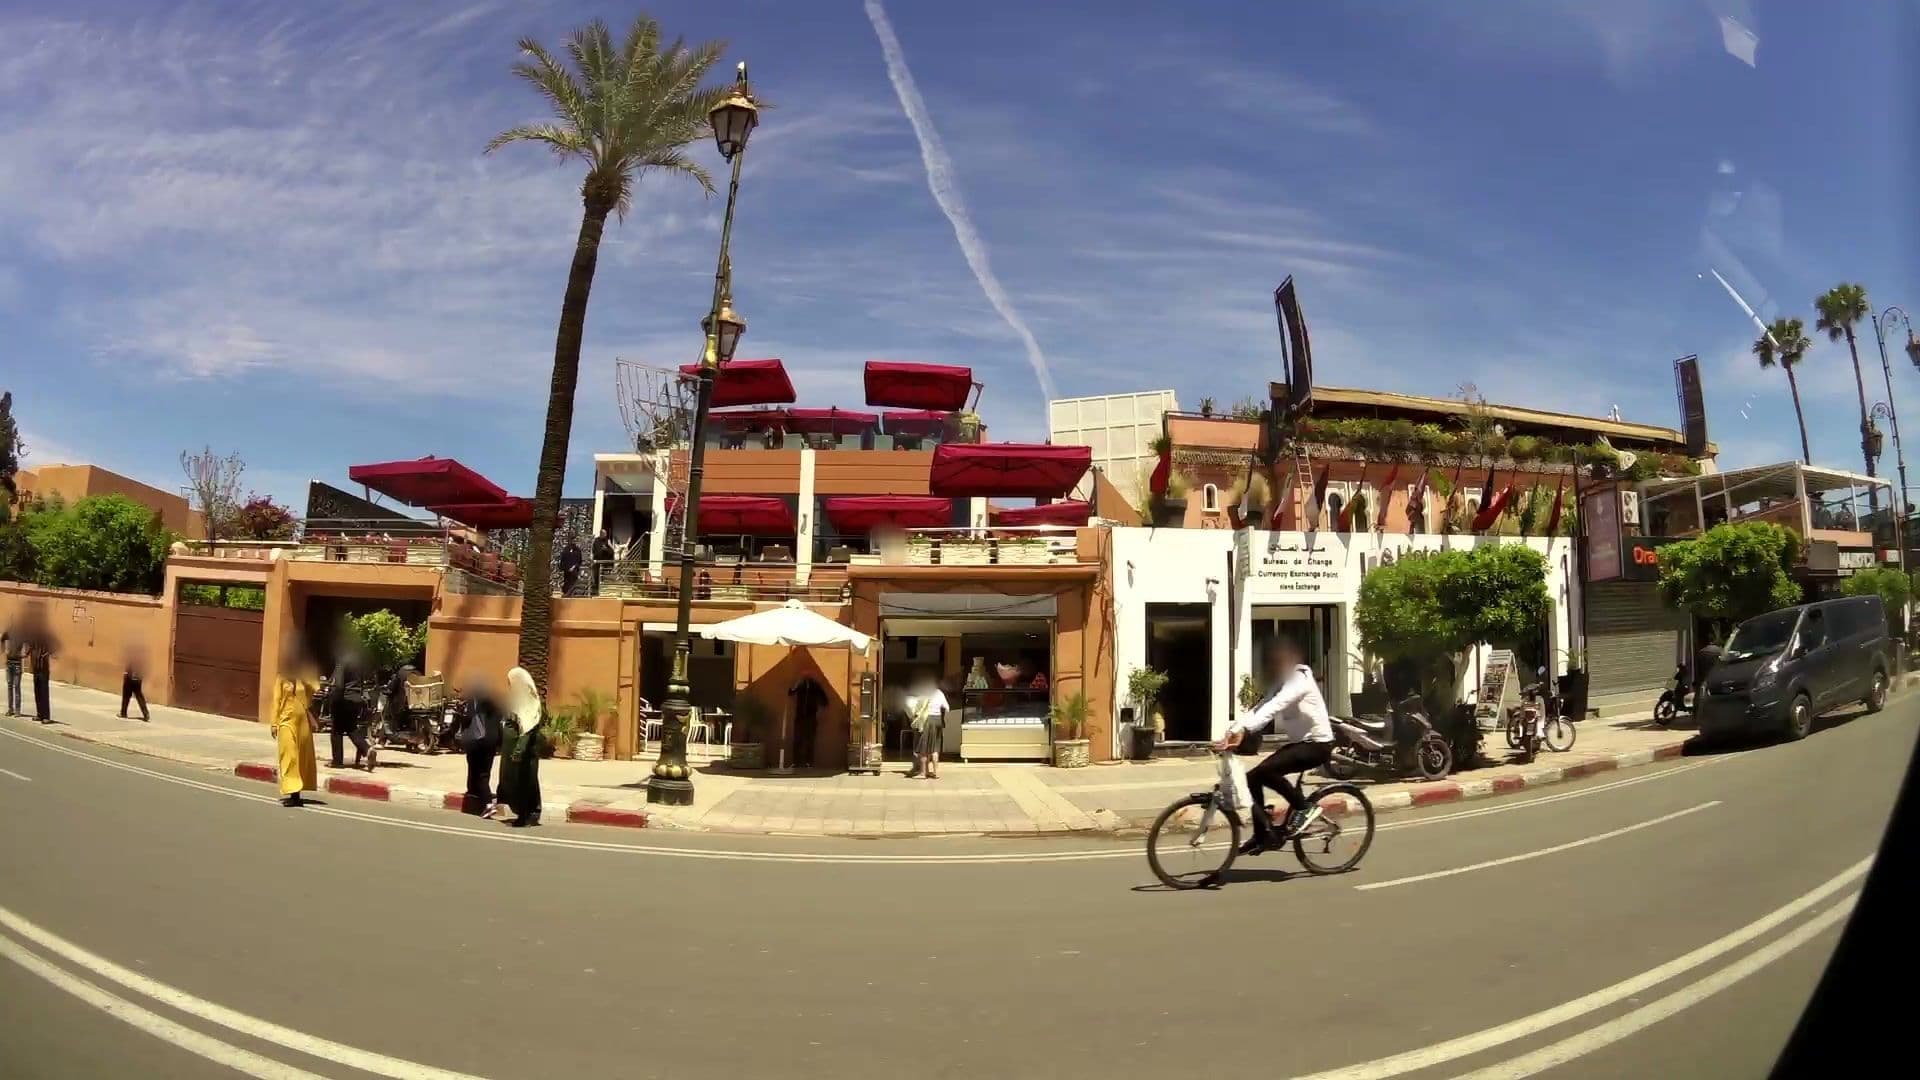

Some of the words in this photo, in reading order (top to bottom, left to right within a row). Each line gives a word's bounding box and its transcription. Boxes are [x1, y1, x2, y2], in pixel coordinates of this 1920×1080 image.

[1633, 545, 1659, 565] Ora
[1263, 557, 1288, 565] Bureau
[1293, 557, 1302, 565] de
[1307, 558, 1333, 567] Change
[1258, 570, 1288, 579] Currency
[1289, 570, 1321, 579] Exchange
[1322, 571, 1339, 579] Point
